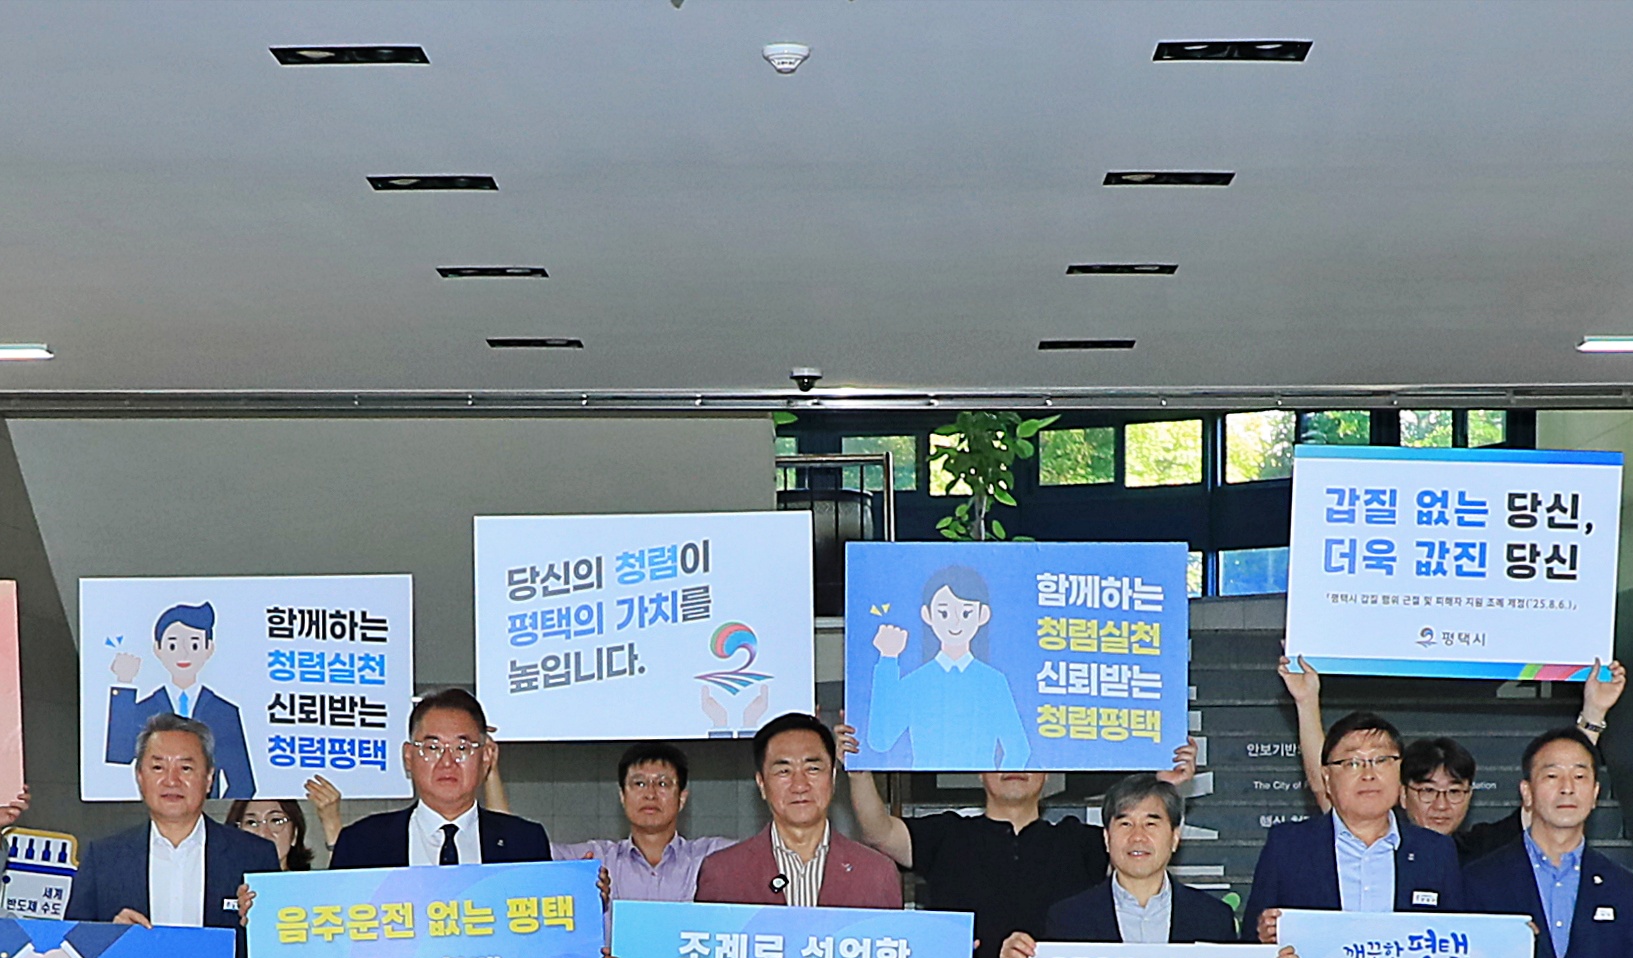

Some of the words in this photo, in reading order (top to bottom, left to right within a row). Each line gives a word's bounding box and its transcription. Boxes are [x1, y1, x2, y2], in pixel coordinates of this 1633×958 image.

[1325, 488, 1397, 525] 갑질
[1416, 490, 1489, 528] 없는
[1506, 492, 1594, 534] 당신,
[507, 556, 603, 600] 당신의
[615, 539, 710, 585] 청렴이
[1323, 538, 1397, 576] 더욱
[1415, 540, 1488, 578] 값진
[1505, 543, 1578, 580] 당신
[1036, 572, 1164, 612] 함께하는
[267, 607, 388, 642] 함께하는
[507, 602, 604, 647] 평택의
[617, 585, 711, 631] 가치를
[1036, 617, 1161, 656] 청렴실천
[1441, 631, 1486, 646] 평택시
[268, 650, 386, 685] 청렴실천
[508, 642, 646, 694] 높입니다.
[1036, 661, 1162, 699] 신뢰받는
[268, 693, 387, 728] 신뢰받는
[1036, 704, 1161, 744] 청렴평택
[268, 735, 387, 771] 청렴평택
[1247, 743, 1301, 757] 안보기반
[1253, 781, 1270, 789] The
[1273, 781, 1290, 791] City
[41, 901, 62, 915] 수도
[275, 902, 415, 943] 음주운전
[427, 900, 495, 937] 없는
[507, 896, 575, 933] 평택
